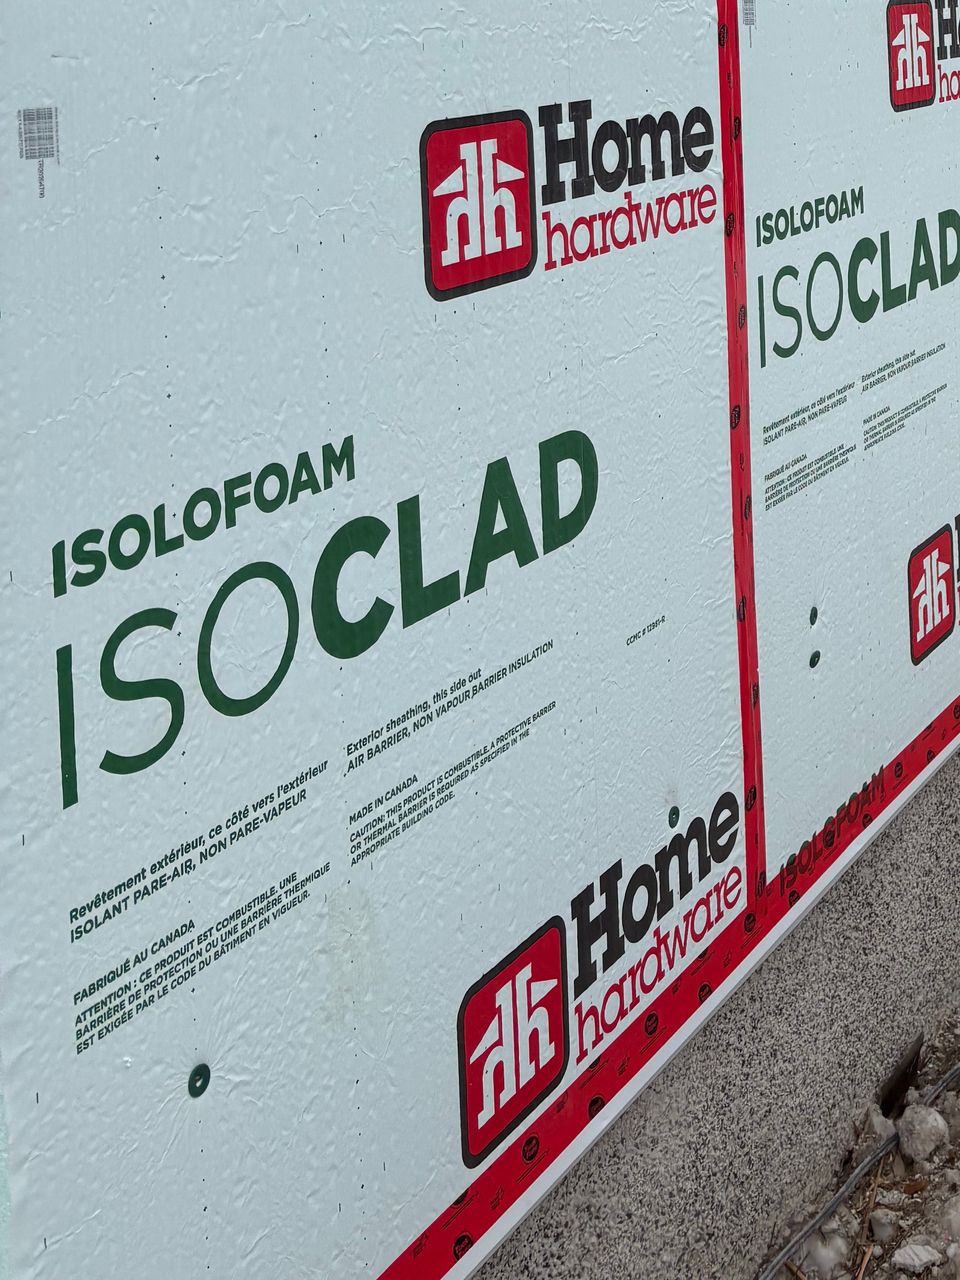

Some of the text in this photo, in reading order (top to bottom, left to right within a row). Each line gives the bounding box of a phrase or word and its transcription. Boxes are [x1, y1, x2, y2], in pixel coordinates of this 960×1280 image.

[538, 99, 714, 206] Home
[541, 184, 717, 272] hardware
[755, 186, 864, 248] ISOLOFOAM
[52, 435, 355, 598] ISOLOFOAM
[56, 430, 598, 810] ISOCLAD
[68, 867, 147, 925] Revêtement
[149, 834, 205, 875] extérieur,
[207, 824, 223, 840] ce
[224, 804, 249, 831] côté
[251, 792, 275, 813] vers
[69, 788, 307, 944] ISOLANT PARE-AIR, NON PARE-VAPEUR
[570, 791, 741, 1001] Home
[779, 763, 886, 896] ISOLOFOAM
[72, 919, 195, 1006] FABRIQUÉ AU CANADA
[74, 981, 132, 1027] ATTENTION
[138, 967, 152, 984] CE
[153, 938, 195, 975] PRODUIT
[195, 926, 214, 946] EST
[214, 885, 278, 933] COMBUSTIBLE.
[278, 871, 297, 892] UNE
[74, 861, 331, 1041] BARRIÈRE DE PROTECTION OU UNE BARRIÈRE THERMIQUE
[75, 889, 311, 1055] EST EXIGÉE PAR LE CODE DU BÂTIMENT EN VIGUEUR.
[573, 866, 743, 1065] hardware
